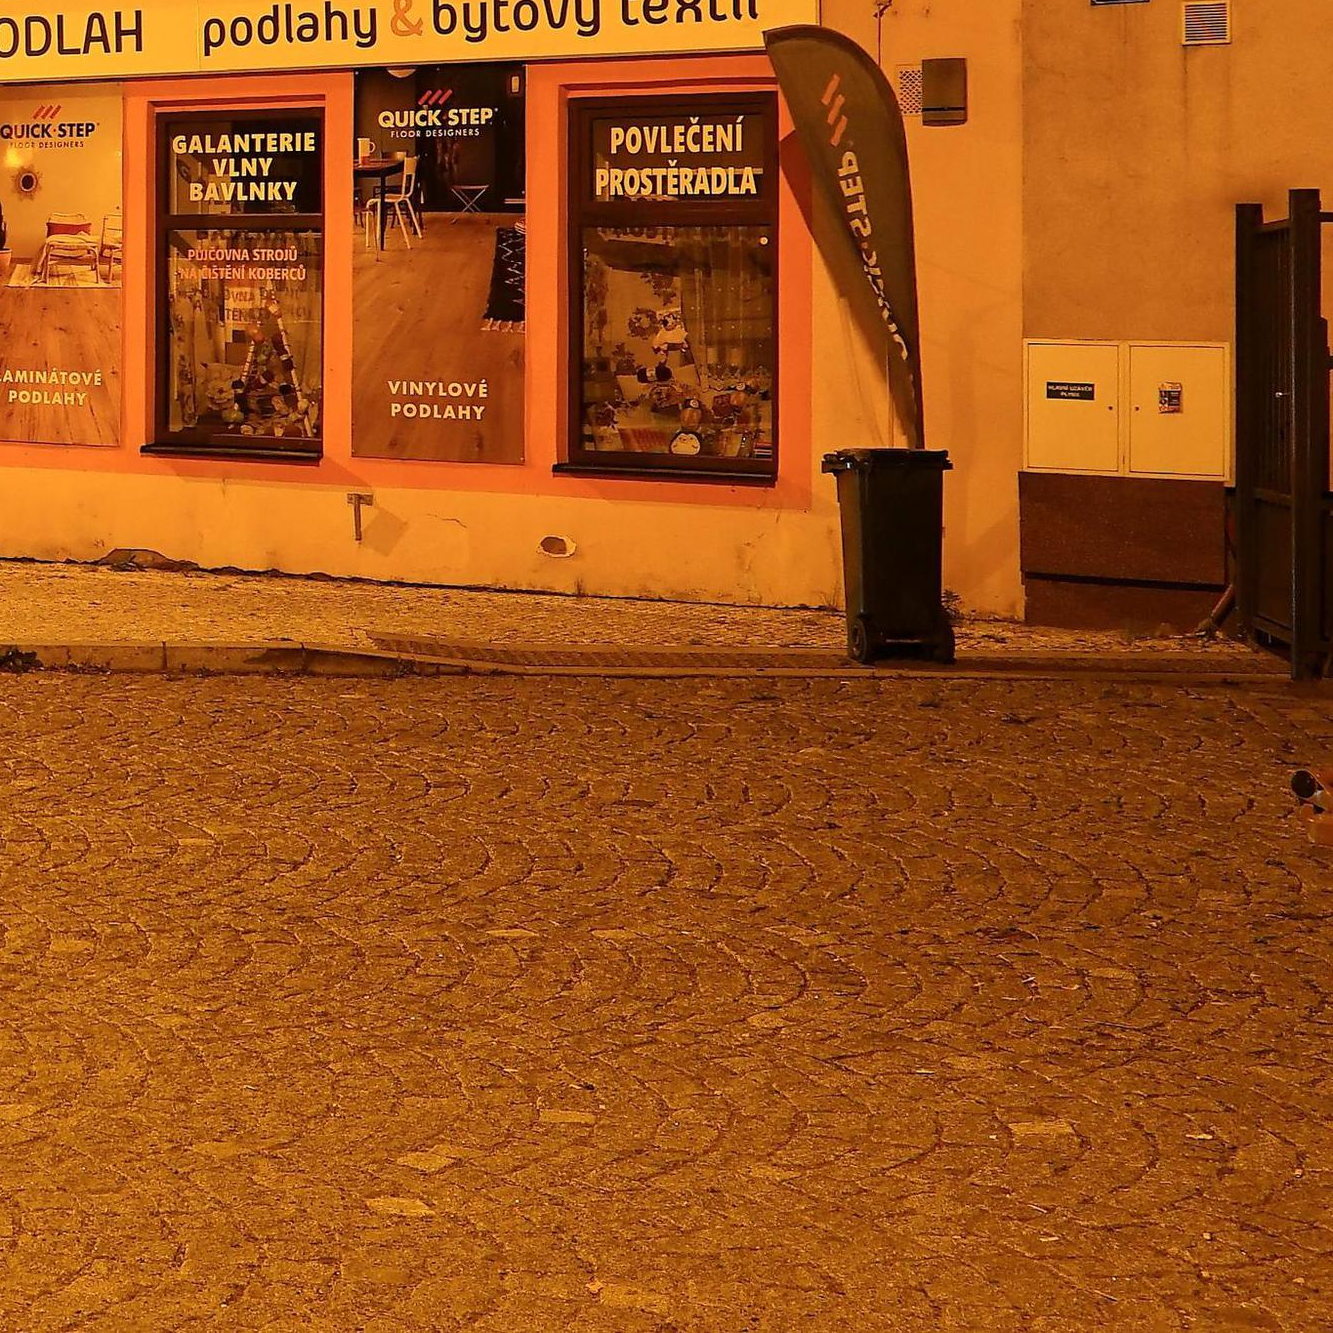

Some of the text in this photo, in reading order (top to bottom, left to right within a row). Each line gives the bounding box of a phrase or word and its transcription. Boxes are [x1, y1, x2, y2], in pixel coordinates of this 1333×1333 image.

[202, 0, 377, 56] podlahy
[172, 132, 316, 155] GALANTERIE
[390, 127, 480, 139] FLOOR DESIGNERS
[610, 116, 743, 155] POVLEČENÍ
[38, 140, 84, 149] DESIGNERS
[212, 157, 274, 178] VLNY
[595, 159, 758, 197] PROSTĚRADLA
[188, 181, 298, 203] BAVLNKY
[187, 245, 298, 262] PŮJČOVNA STROJŮ
[180, 268, 198, 280] NA
[248, 263, 307, 281] KOBERCŮ
[8, 389, 87, 407] PODLAHY
[387, 378, 490, 399] VINYLOVÉ
[389, 403, 486, 422] PODLAHY
